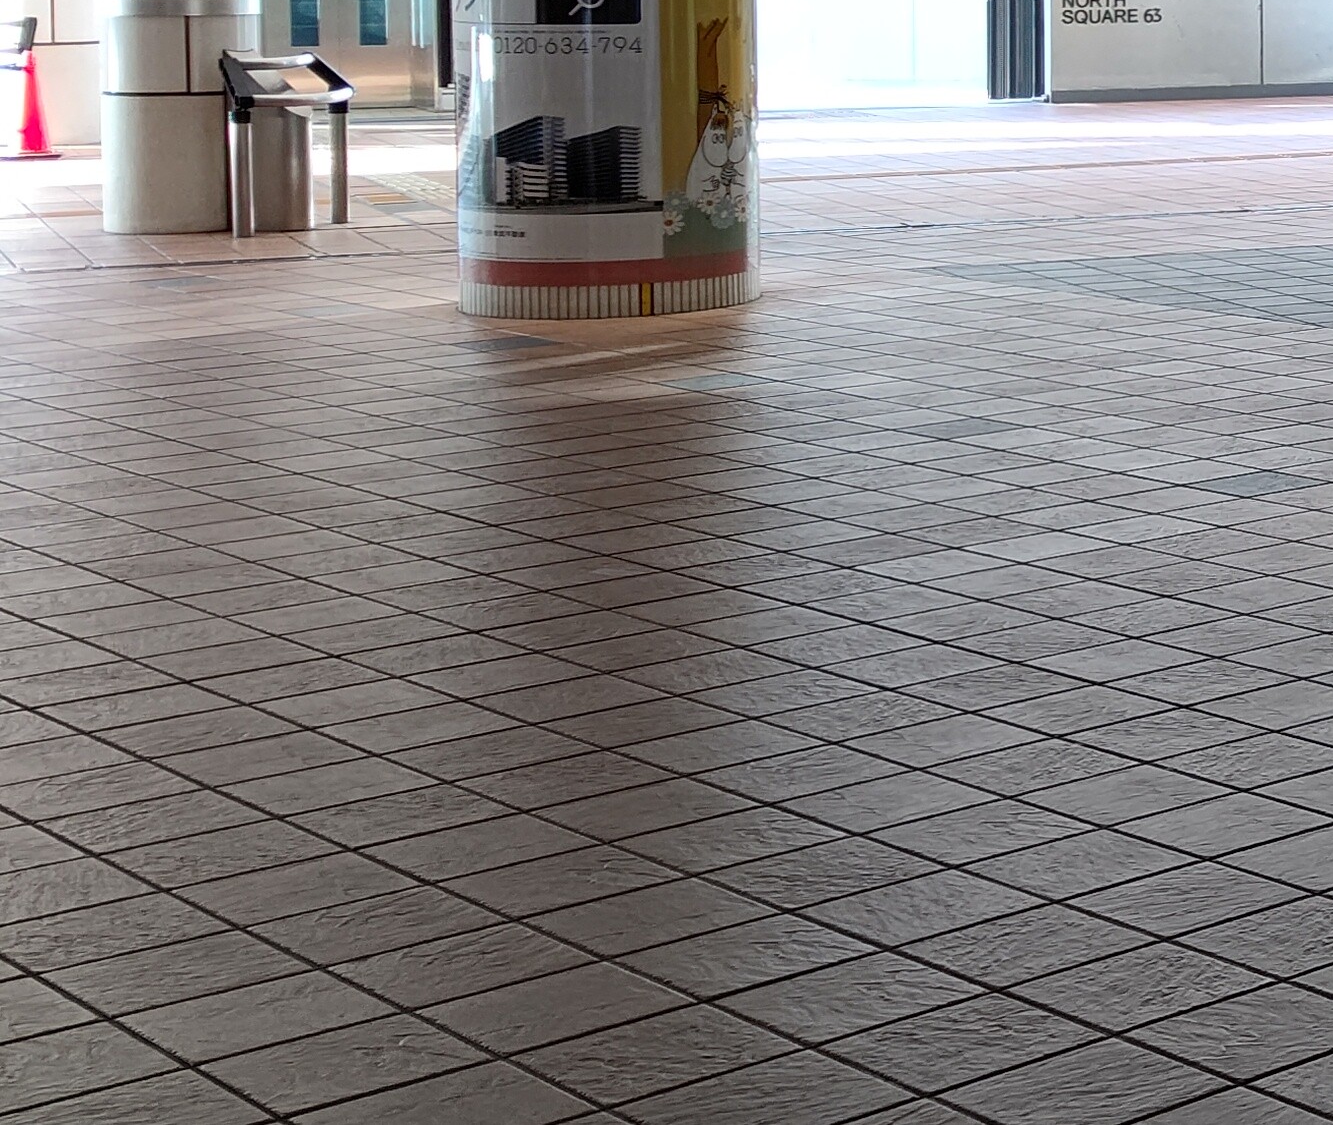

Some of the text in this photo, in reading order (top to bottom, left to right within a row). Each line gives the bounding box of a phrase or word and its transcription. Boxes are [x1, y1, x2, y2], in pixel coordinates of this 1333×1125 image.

[1062, 7, 1162, 24] SQUARE 63
[493, 36, 644, 55] 0120-634-794
